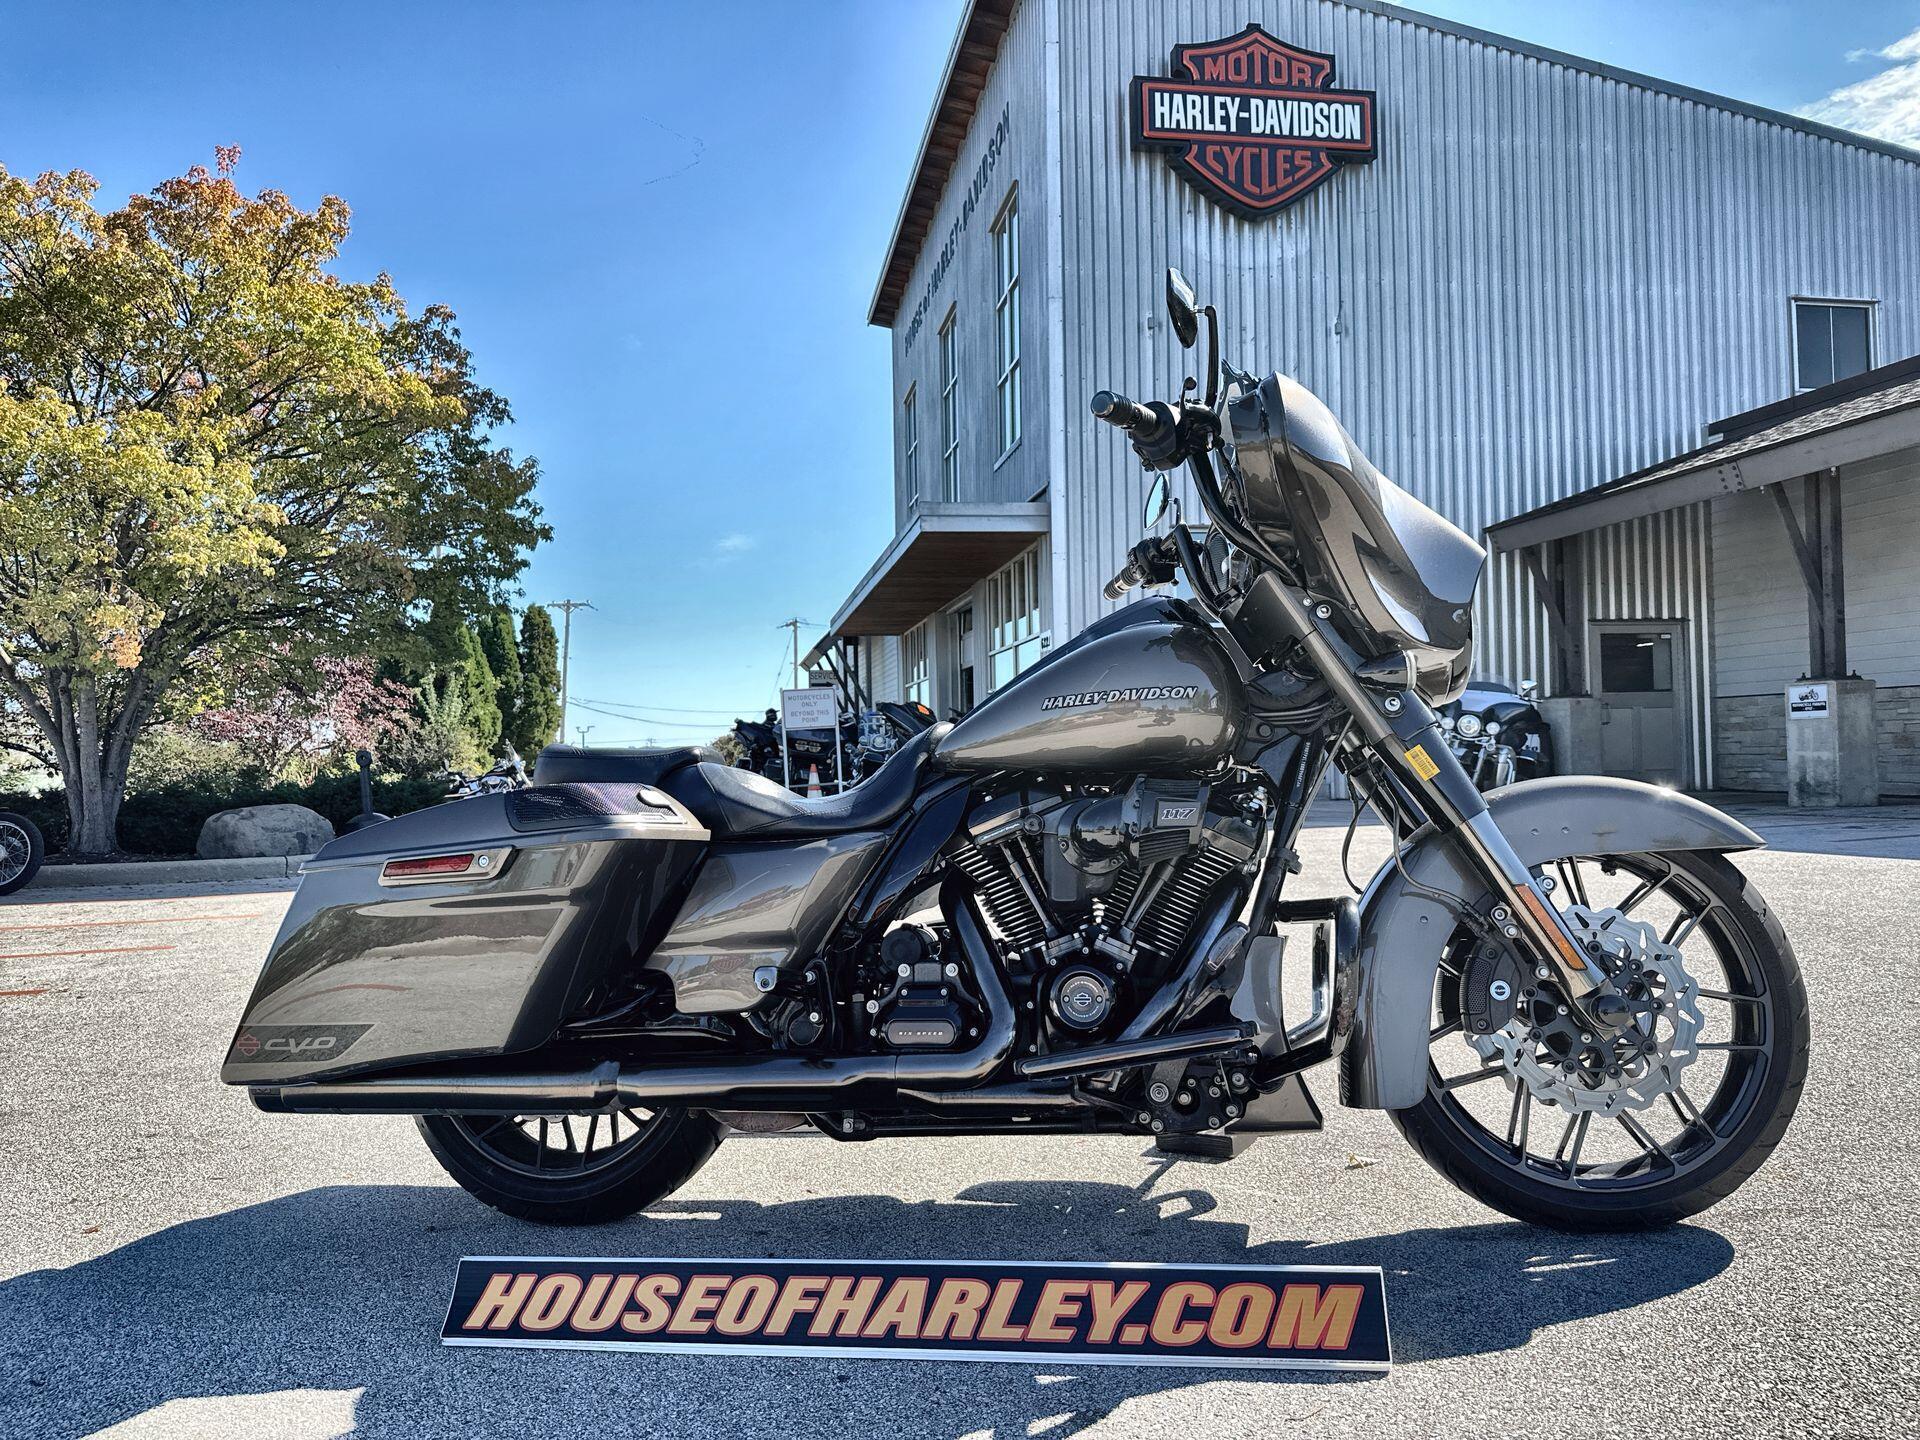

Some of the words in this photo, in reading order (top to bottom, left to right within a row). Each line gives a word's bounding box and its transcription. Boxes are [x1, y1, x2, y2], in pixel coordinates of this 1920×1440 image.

[1203, 43, 1312, 88] MOTOR
[1154, 92, 1361, 140] HARLEY-DAVIDSON
[1205, 145, 1312, 195] CYCLES
[1041, 686, 1198, 711] HARLEY-DAVIDSON
[1161, 807, 1197, 820] 117
[264, 1036, 337, 1053] CVO
[461, 1273, 1365, 1350] HOUSEOFHARLEY.COM
